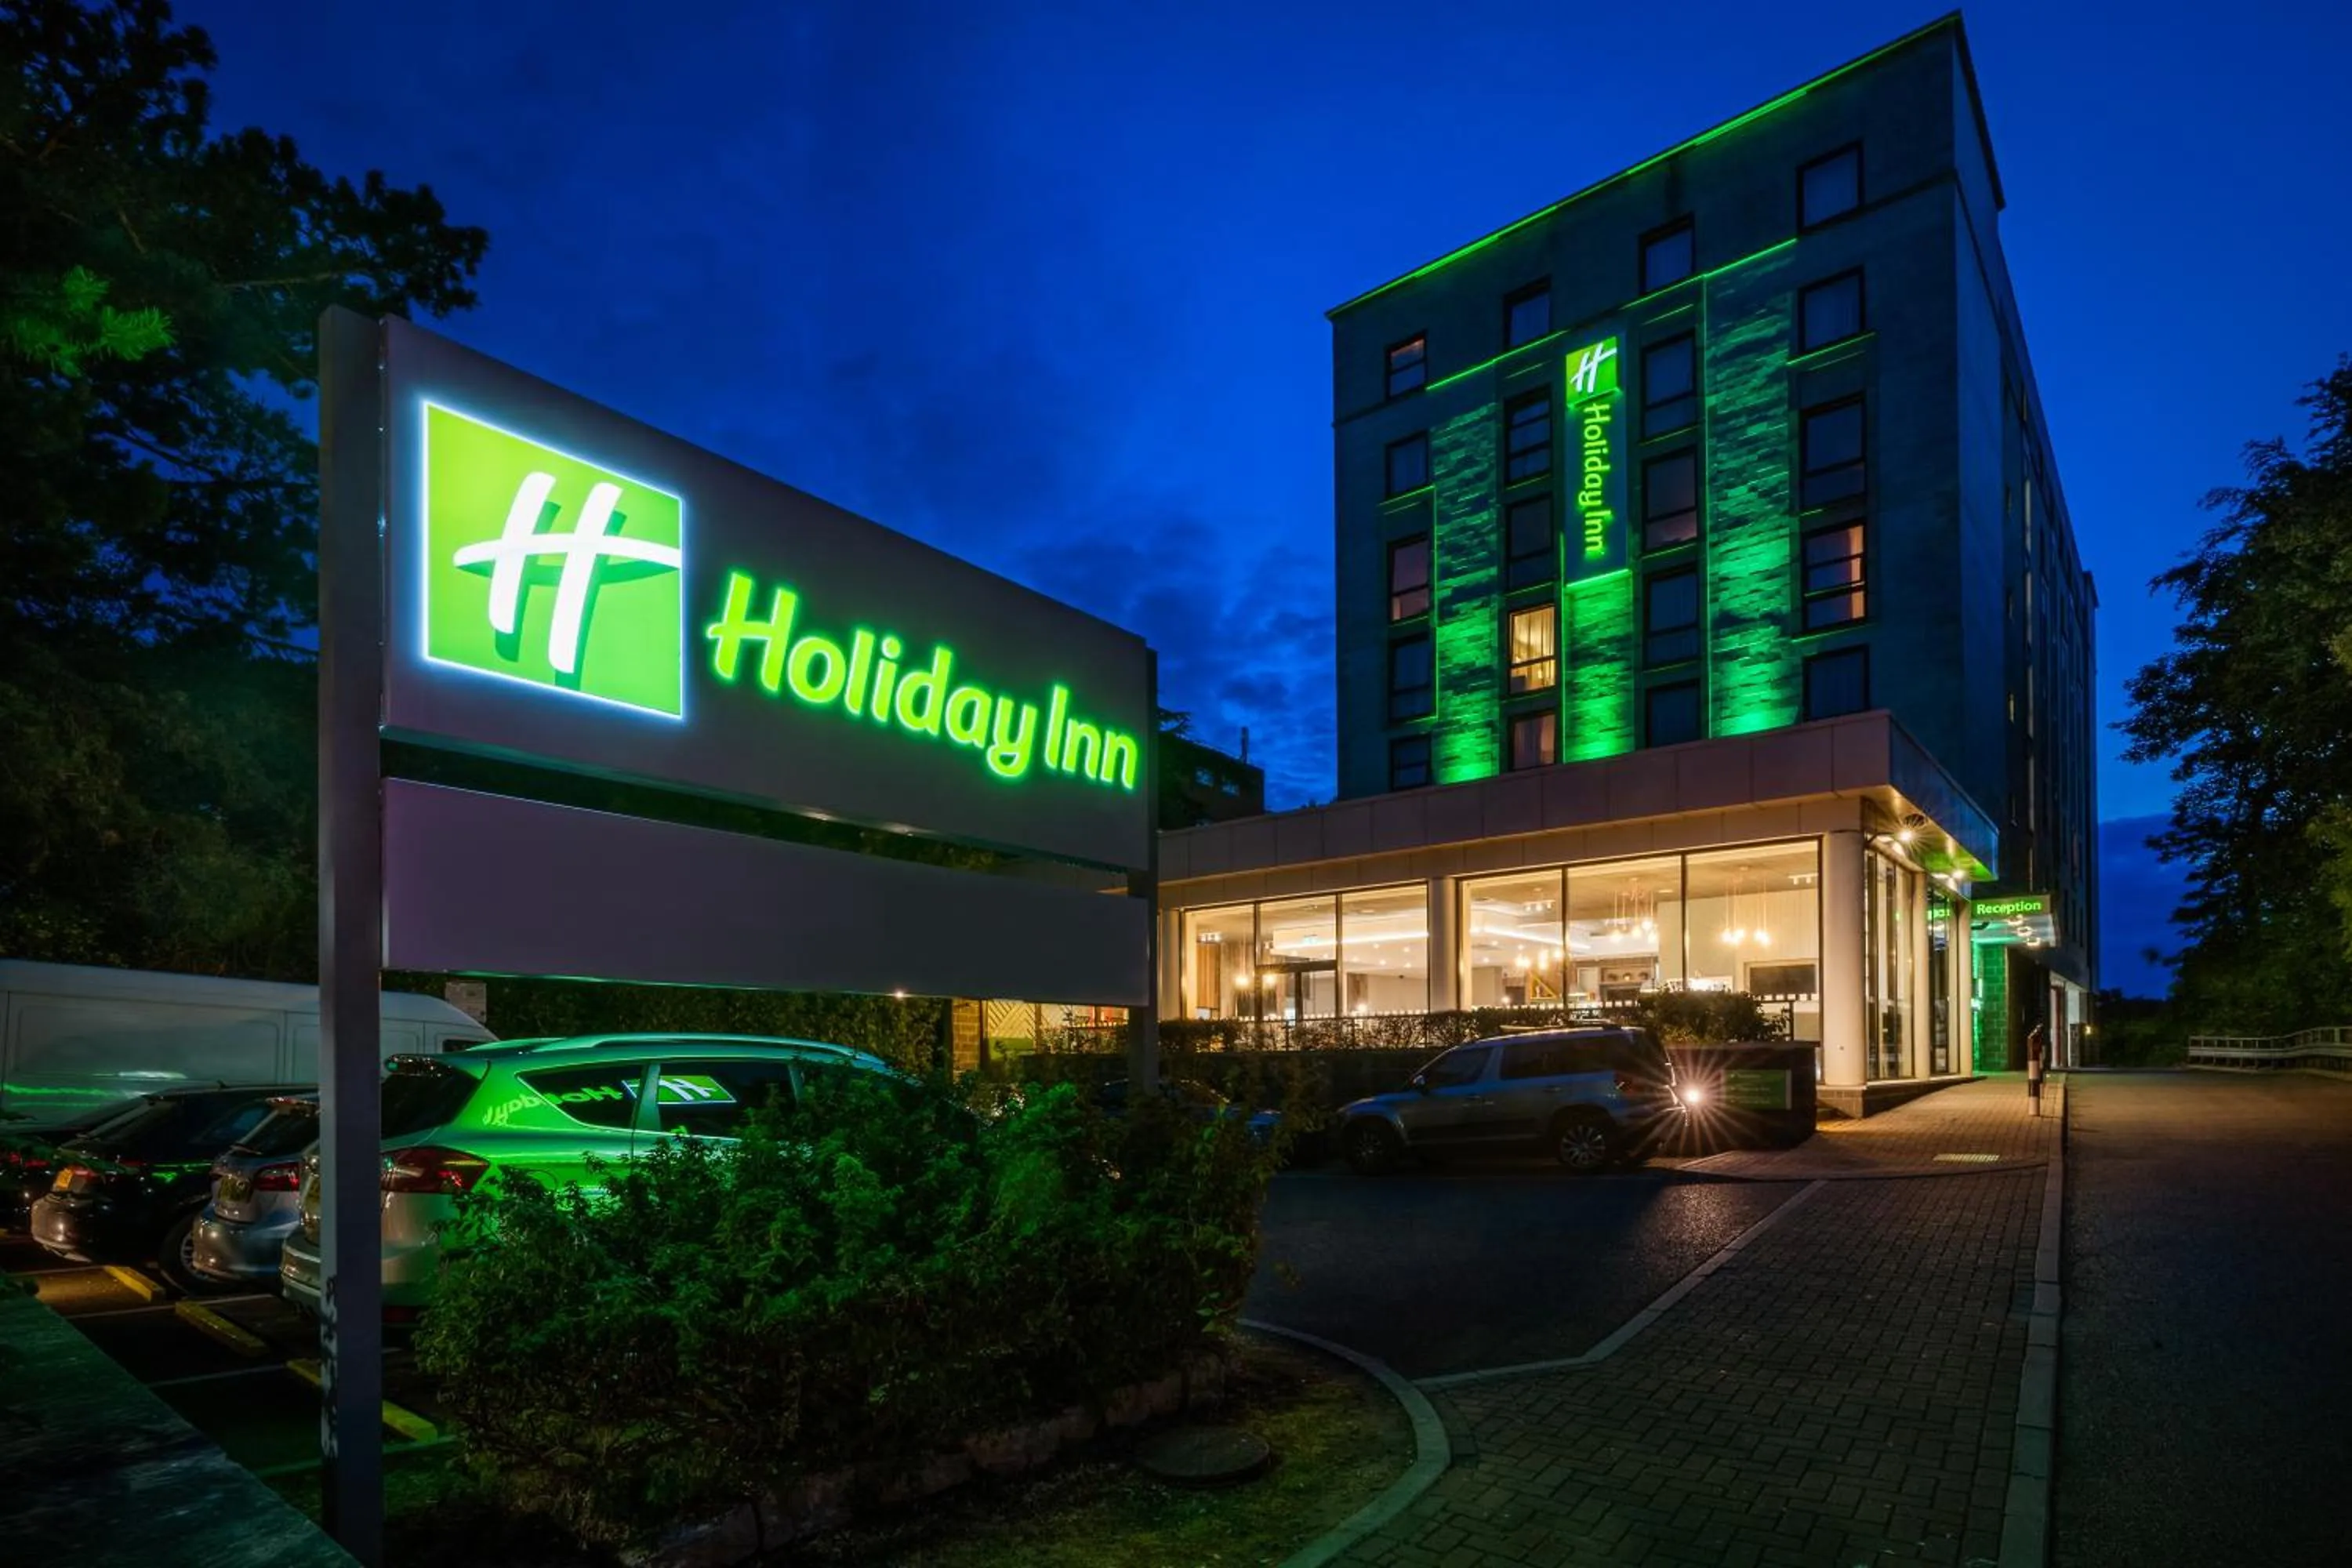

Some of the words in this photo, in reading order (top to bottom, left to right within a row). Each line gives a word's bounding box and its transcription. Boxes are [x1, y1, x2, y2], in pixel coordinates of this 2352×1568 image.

[1577, 403, 1611, 506] Holiday
[1584, 510, 1611, 556] Inn
[707, 572, 1039, 777] Holiday
[1045, 684, 1138, 790] Inn
[1976, 901, 2042, 915] Reception
